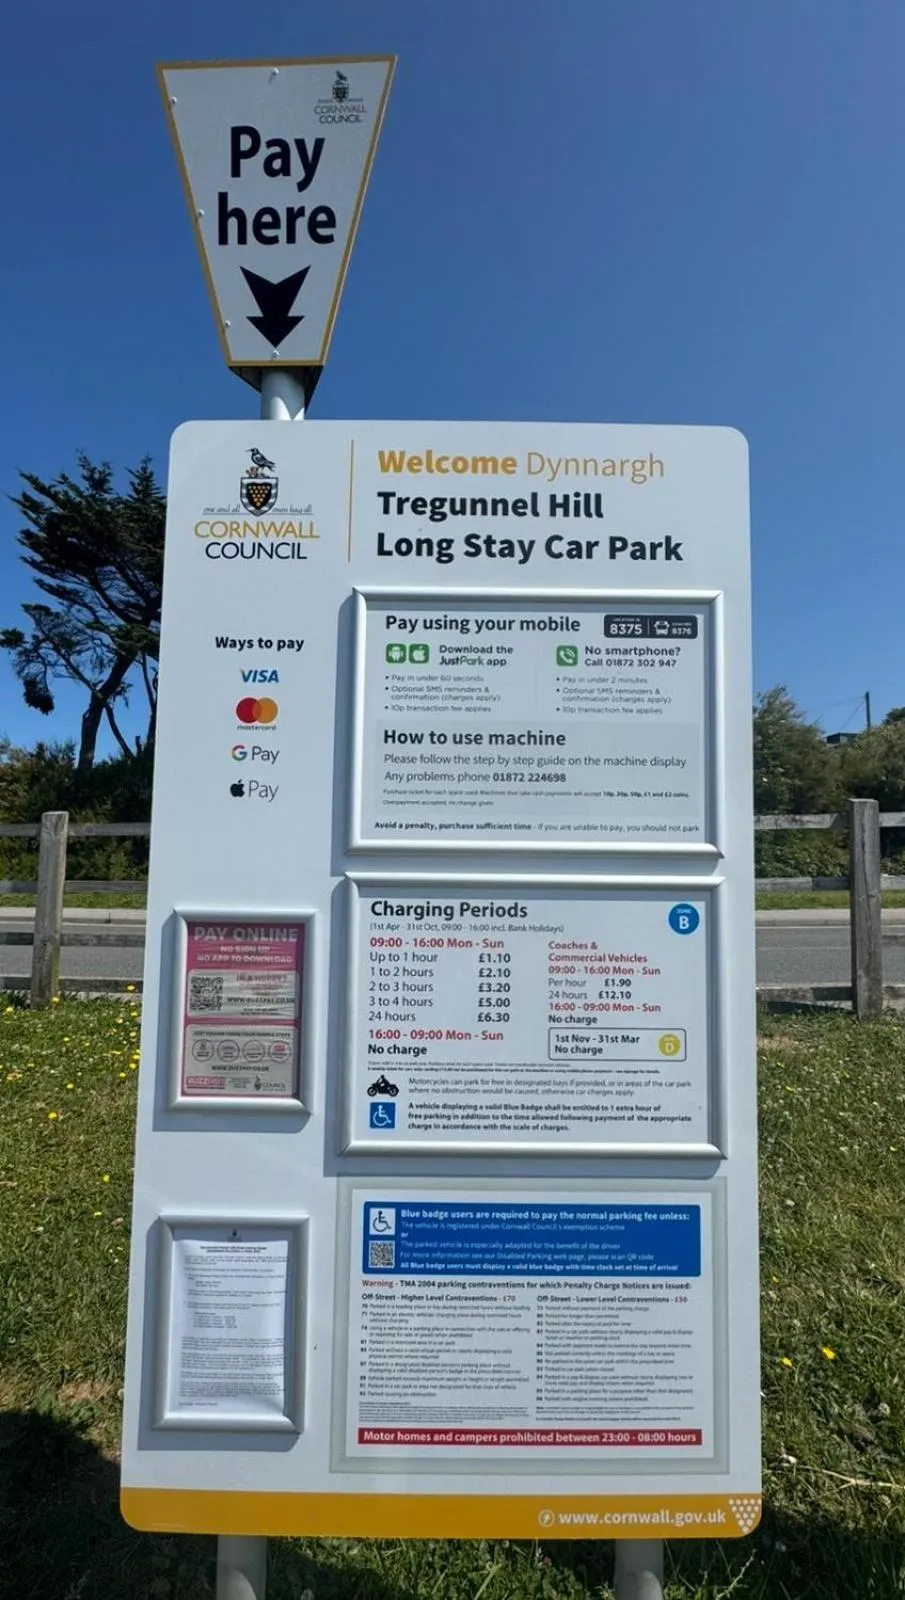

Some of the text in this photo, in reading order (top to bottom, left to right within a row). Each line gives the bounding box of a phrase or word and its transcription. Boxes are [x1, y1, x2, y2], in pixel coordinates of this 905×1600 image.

[314, 105, 366, 123] CORNWALL COUNCIL
[230, 125, 325, 192] Pay
[218, 192, 336, 245] here
[378, 450, 664, 483] Welcome Dynnargh
[377, 491, 604, 522] Tregunnel Hill
[194, 521, 320, 559] CORNWALL COUNCIL
[377, 533, 683, 564] Long Stay Car Park
[386, 615, 581, 634] Pay using your mobile
[610, 624, 642, 634] 8375
[215, 637, 304, 652] Ways to pay
[440, 645, 513, 654] Download the
[585, 646, 681, 656] No smartphone?
[440, 656, 507, 666] JustPark app
[585, 658, 676, 667] Call 01872 302 947
[240, 670, 279, 683] VISA
[384, 730, 566, 746] How to use machine
[252, 746, 279, 764] Pay
[384, 754, 687, 768] Please follow the step by step guide on the machine display
[384, 772, 566, 783] Any problems phone 01872 224698
[249, 781, 279, 802] Pay
[371, 901, 527, 921] Charging Periods
[679, 916, 689, 929] B
[194, 927, 298, 941] PAY ONLINE
[370, 938, 402, 947] 09:00
[413, 938, 444, 948] 16:00
[447, 938, 472, 948] Mon
[482, 939, 504, 948] Sun
[549, 941, 588, 950] Coaches
[370, 952, 510, 964] Up to 1 hour £1.10
[549, 954, 647, 962] Commercial Vehicles
[371, 967, 510, 978] 1 to 2 hours £2.10
[549, 966, 575, 974] 09:00
[613, 967, 633, 975] Mon
[643, 967, 660, 975] Sun
[369, 982, 510, 992] 2 to 3 hours £3.20
[565, 978, 586, 986] hour
[605, 979, 631, 987] £1.90
[549, 991, 631, 999] 24 hours £12.10
[369, 997, 510, 1007] 3 to 4 hours £5.00
[369, 1011, 510, 1022] 24 hours £6.30
[369, 1030, 400, 1039] 16:00
[410, 1030, 442, 1039] 09:00
[445, 1030, 471, 1040] Mon
[481, 1031, 503, 1040] Sun
[556, 1035, 569, 1043] 1st
[572, 1035, 590, 1043] Nov
[598, 1035, 618, 1043] 31st
[621, 1035, 640, 1043] Mar
[368, 1044, 427, 1057] No charge
[554, 1045, 603, 1056] No charge
[401, 1210, 420, 1218] Blue
[423, 1210, 448, 1220] badge
[492, 1211, 528, 1220] required
[576, 1212, 607, 1220] normal
[609, 1213, 642, 1221] parking
[364, 1432, 395, 1440] Motor
[397, 1432, 431, 1441] homes
[434, 1432, 452, 1441] and
[455, 1434, 494, 1443] campers
[500, 1433, 553, 1443] prohibited
[556, 1433, 599, 1442] between
[602, 1433, 630, 1441] 23:00
[638, 1434, 665, 1442] 08:00
[668, 1433, 696, 1442] hours
[559, 1510, 726, 1527] www.cornwall.gov.uk
